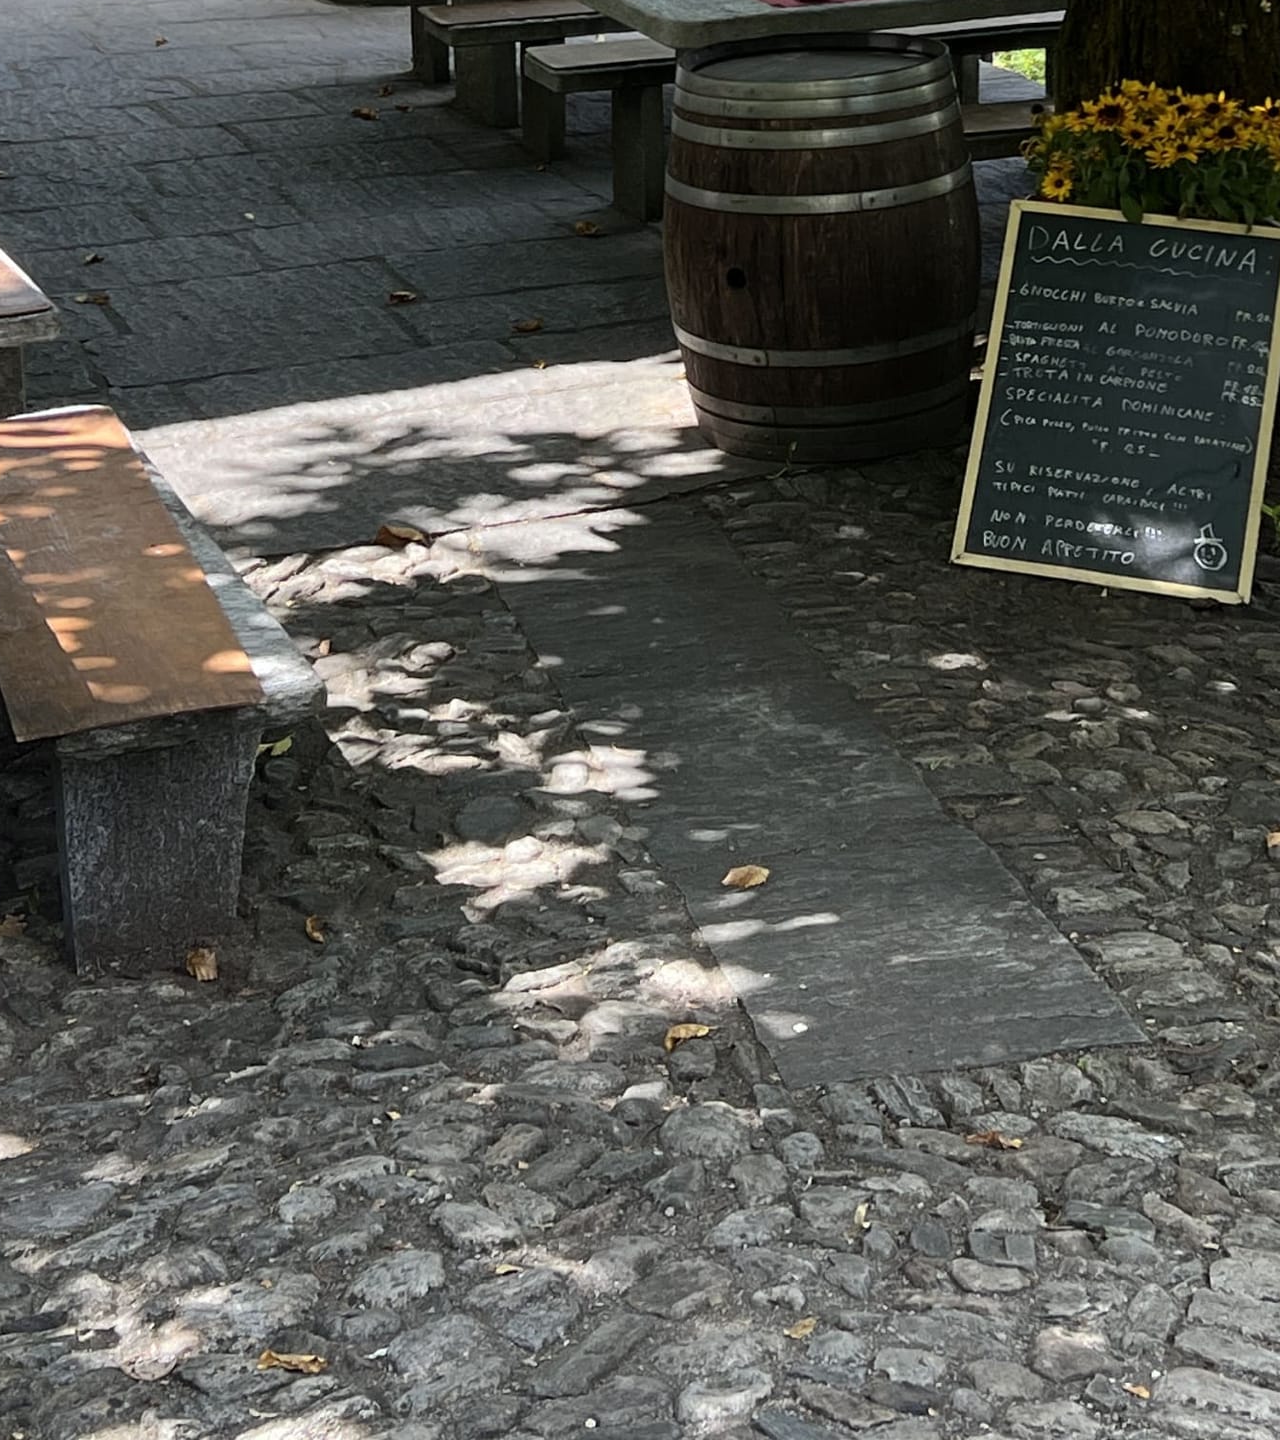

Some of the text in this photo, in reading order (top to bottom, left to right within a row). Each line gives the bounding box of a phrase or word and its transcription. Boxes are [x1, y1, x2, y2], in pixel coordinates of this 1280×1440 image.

[1028, 225, 1124, 253] DALLA
[1020, 282, 1087, 302] GNOCCHI
[1150, 298, 1198, 315] SALVIA
[1098, 321, 1118, 334] AL
[1135, 323, 1229, 346] POMODORO
[1013, 366, 1068, 381] TROTA
[1077, 373, 1093, 382] IN
[1100, 374, 1168, 393] CARPIONE
[995, 460, 1016, 474] SU
[1167, 483, 1211, 501] ALTRI
[990, 509, 1026, 524] NON
[983, 530, 1136, 564] BUON APPETITO
